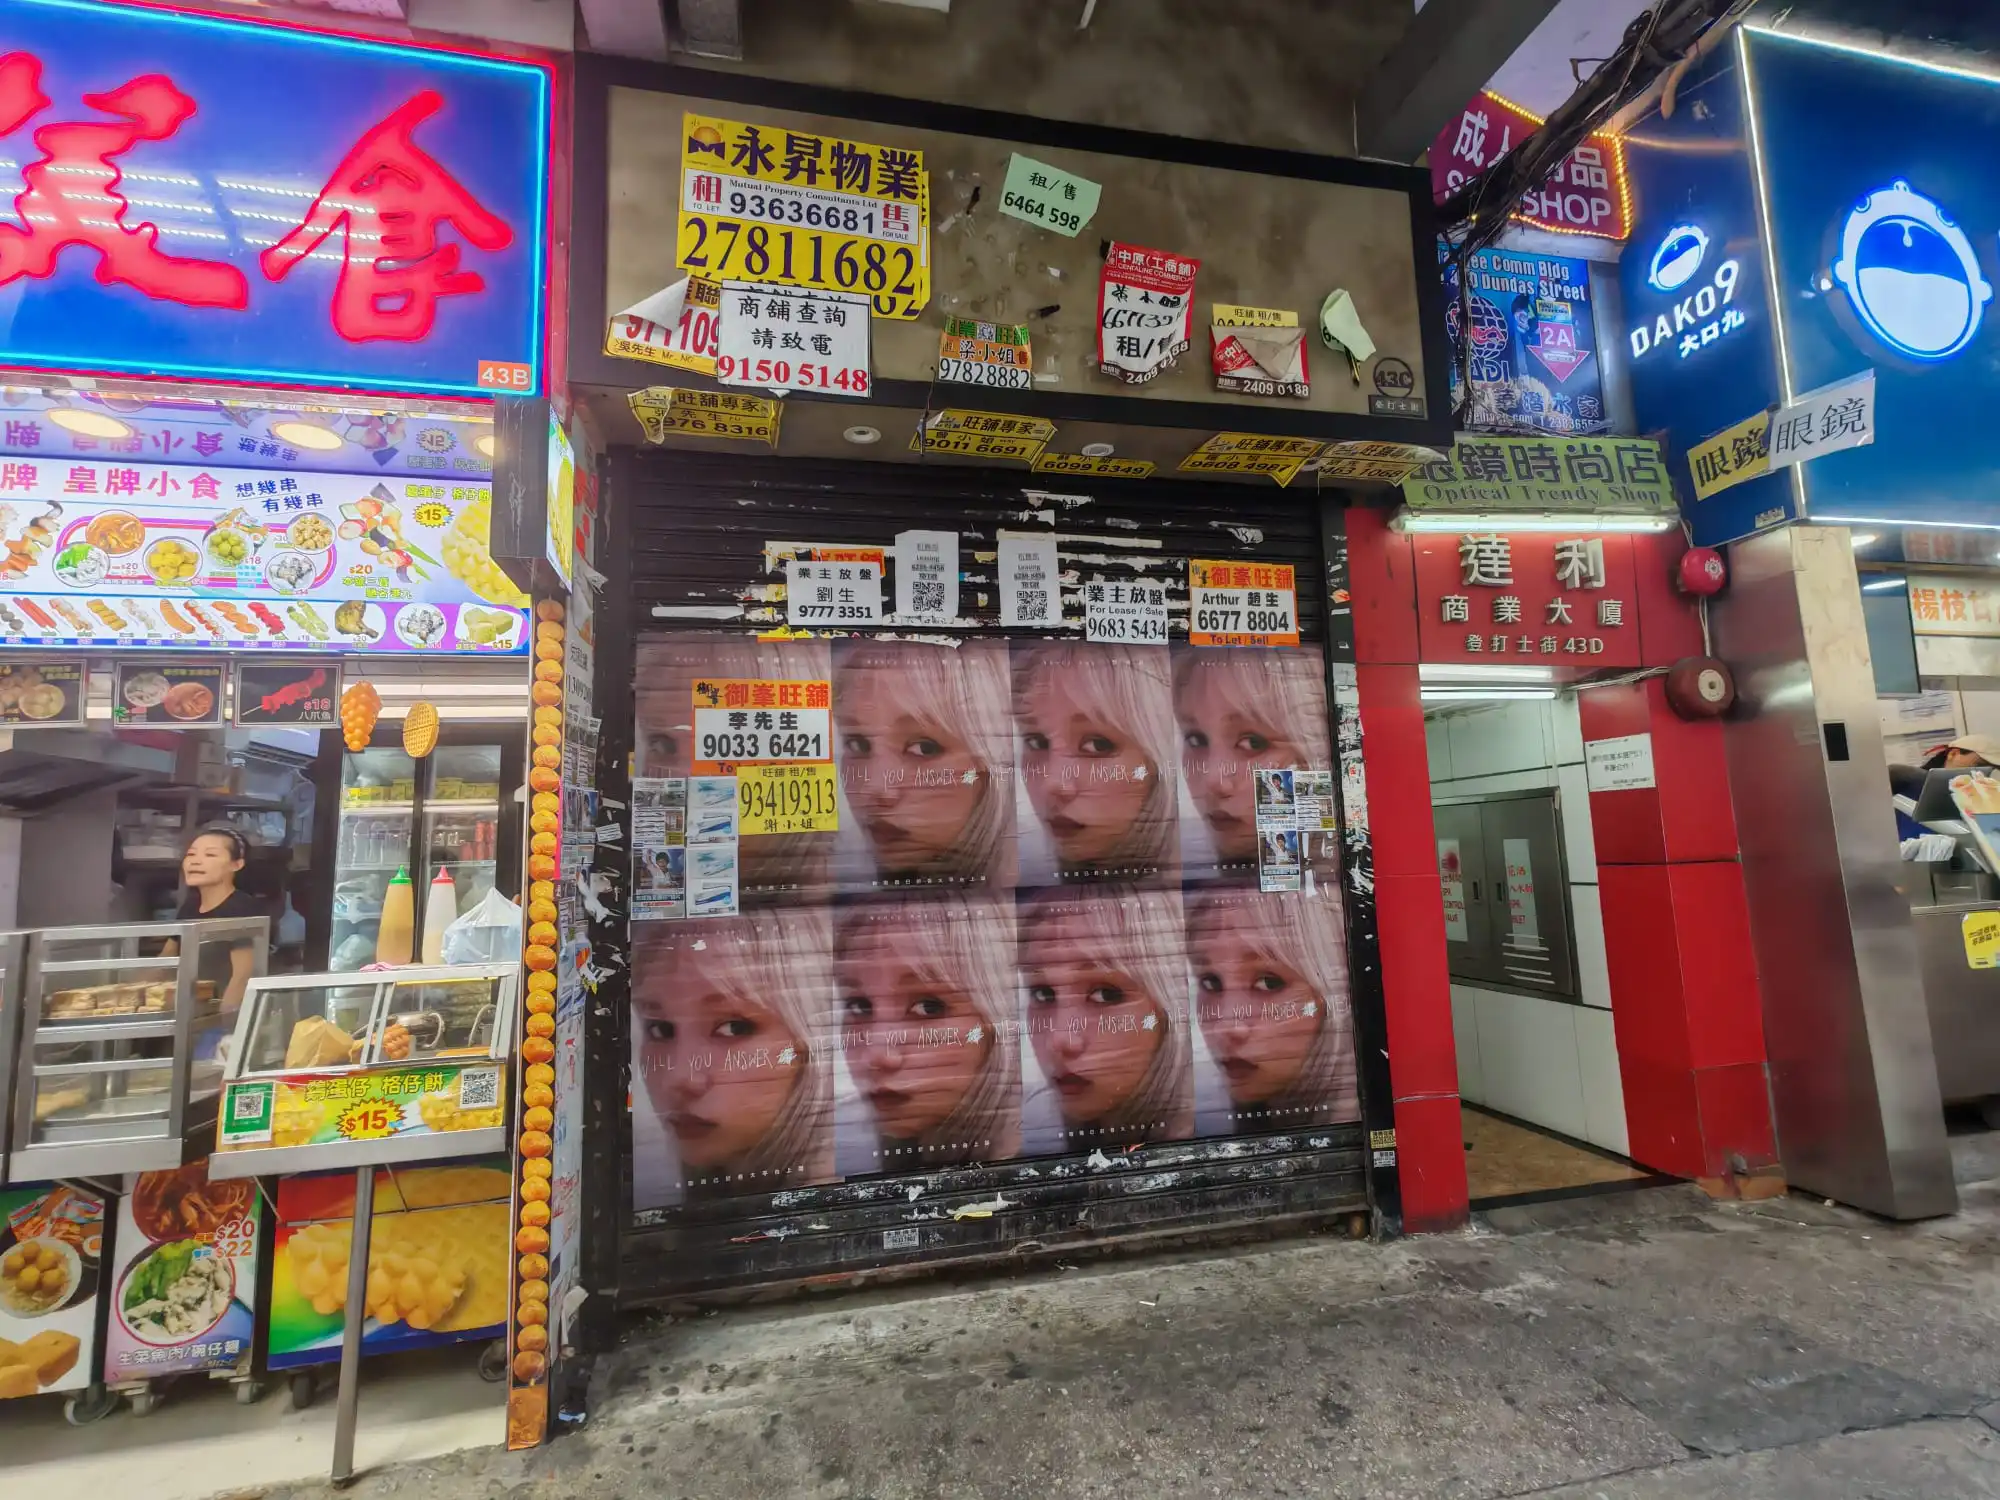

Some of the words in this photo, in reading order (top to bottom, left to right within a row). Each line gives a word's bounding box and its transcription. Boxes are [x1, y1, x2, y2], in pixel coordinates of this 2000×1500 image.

[731, 126, 919, 199] 永昇物業
[692, 174, 722, 204] 租
[730, 178, 762, 192] Mutual
[764, 184, 803, 198] Property
[862, 199, 878, 209] Ltd
[1029, 171, 1078, 201] 租/售
[730, 192, 875, 234] 93636681
[882, 203, 909, 232] 售
[1004, 191, 1045, 218] 6464
[1049, 207, 1080, 231] 598
[1522, 190, 1612, 226] SHOP
[683, 217, 917, 295] 27811682
[1118, 249, 1197, 277] 中原(工商舖)
[1492, 255, 1536, 276] Comm
[1538, 260, 1569, 281] Bldg
[1481, 275, 1535, 296] Dundas
[1539, 280, 1586, 301] Street
[738, 296, 846, 327] 商舖查詢
[1630, 259, 1740, 358] DAKO9
[751, 328, 832, 356] 請致電
[1543, 327, 1571, 347] 2A
[1679, 310, 1745, 358] 大口九
[960, 340, 1016, 365] 梁小姐
[482, 367, 529, 385] 43B
[719, 355, 790, 384] 9150
[798, 363, 868, 392] 5148
[1243, 379, 1274, 395] 2409
[1278, 382, 1310, 396] 0188
[677, 393, 760, 412] 旺舖專家
[714, 422, 769, 436] 8316
[963, 415, 1036, 434] 旺舖專家
[1776, 398, 1867, 453] 眼鏡
[925, 438, 970, 450] 9011
[976, 444, 1026, 455] 6691
[1696, 427, 1769, 487] 眼鏡
[1044, 460, 1092, 471] 6099
[1097, 463, 1144, 474] 6349
[64, 466, 222, 500] 皇牌小食
[235, 478, 298, 498] 想幾串
[263, 493, 323, 513] 有幾串
[1424, 484, 1510, 504] Optical
[1523, 485, 1600, 505] Trendy
[1610, 486, 1660, 506] Shop
[417, 509, 442, 521] $15
[349, 564, 373, 574] $20
[1459, 533, 1606, 590] 達利
[798, 567, 872, 580] 業主放盤
[816, 586, 855, 603] 劉生
[1087, 586, 1164, 606] 業主放盤
[1202, 592, 1240, 605] Arthur
[799, 605, 835, 618] 9777
[838, 606, 873, 619] 3351
[1089, 606, 1106, 615] For
[1108, 607, 1137, 616] Lease
[1145, 608, 1164, 616] Sale
[1198, 609, 1241, 631] 6677
[1247, 611, 1289, 631] 8804
[1441, 595, 1625, 627] 商業大廈
[1088, 617, 1125, 639] 9683
[1131, 619, 1167, 640] 5434
[1210, 633, 1223, 644] To
[1225, 633, 1241, 644] Let
[1250, 635, 1269, 645] Sell
[492, 640, 512, 649] $15
[1465, 634, 1558, 653] 登打士街
[1564, 637, 1605, 655] 43D
[728, 711, 798, 730] 李先生
[704, 734, 759, 757] 9033
[769, 733, 821, 757] 6421
[763, 767, 785, 778] 旺舖
[790, 766, 816, 777] 租/售
[915, 766, 957, 787] ANSWER
[1090, 763, 1129, 782] ANSWER
[741, 778, 836, 818] 93419313
[764, 819, 814, 831] 謝小姐
[1261, 1002, 1301, 1021] ANSWER
[1097, 1014, 1139, 1036] ANSWER
[918, 1027, 962, 1048] ANSWER
[724, 1048, 773, 1072] ANSWER
[381, 1072, 443, 1096] 格仔餅
[345, 1109, 387, 1133] $15
[215, 1220, 255, 1240] $20
[215, 1240, 253, 1258] $22
